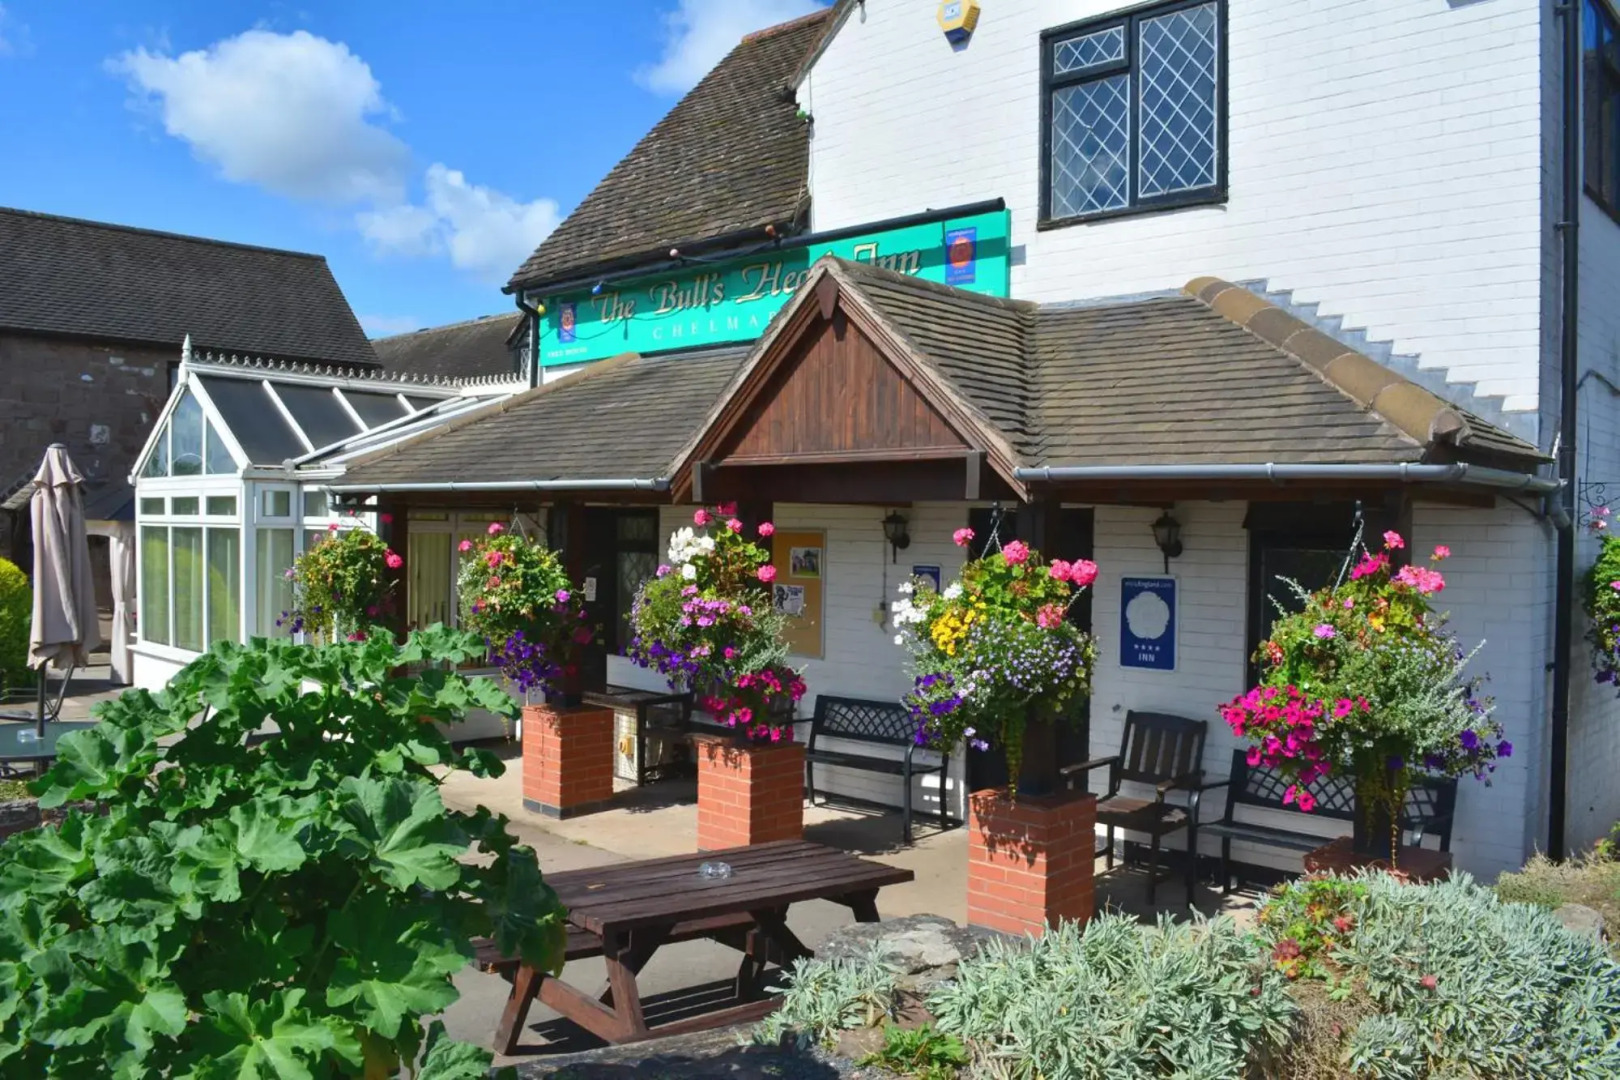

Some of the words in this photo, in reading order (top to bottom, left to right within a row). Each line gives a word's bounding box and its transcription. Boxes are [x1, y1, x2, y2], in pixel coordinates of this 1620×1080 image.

[591, 292, 636, 323] The
[650, 273, 725, 314] Bull's
[731, 251, 834, 304] Hea
[853, 243, 920, 275] Inn
[1138, 653, 1155, 662] INN
